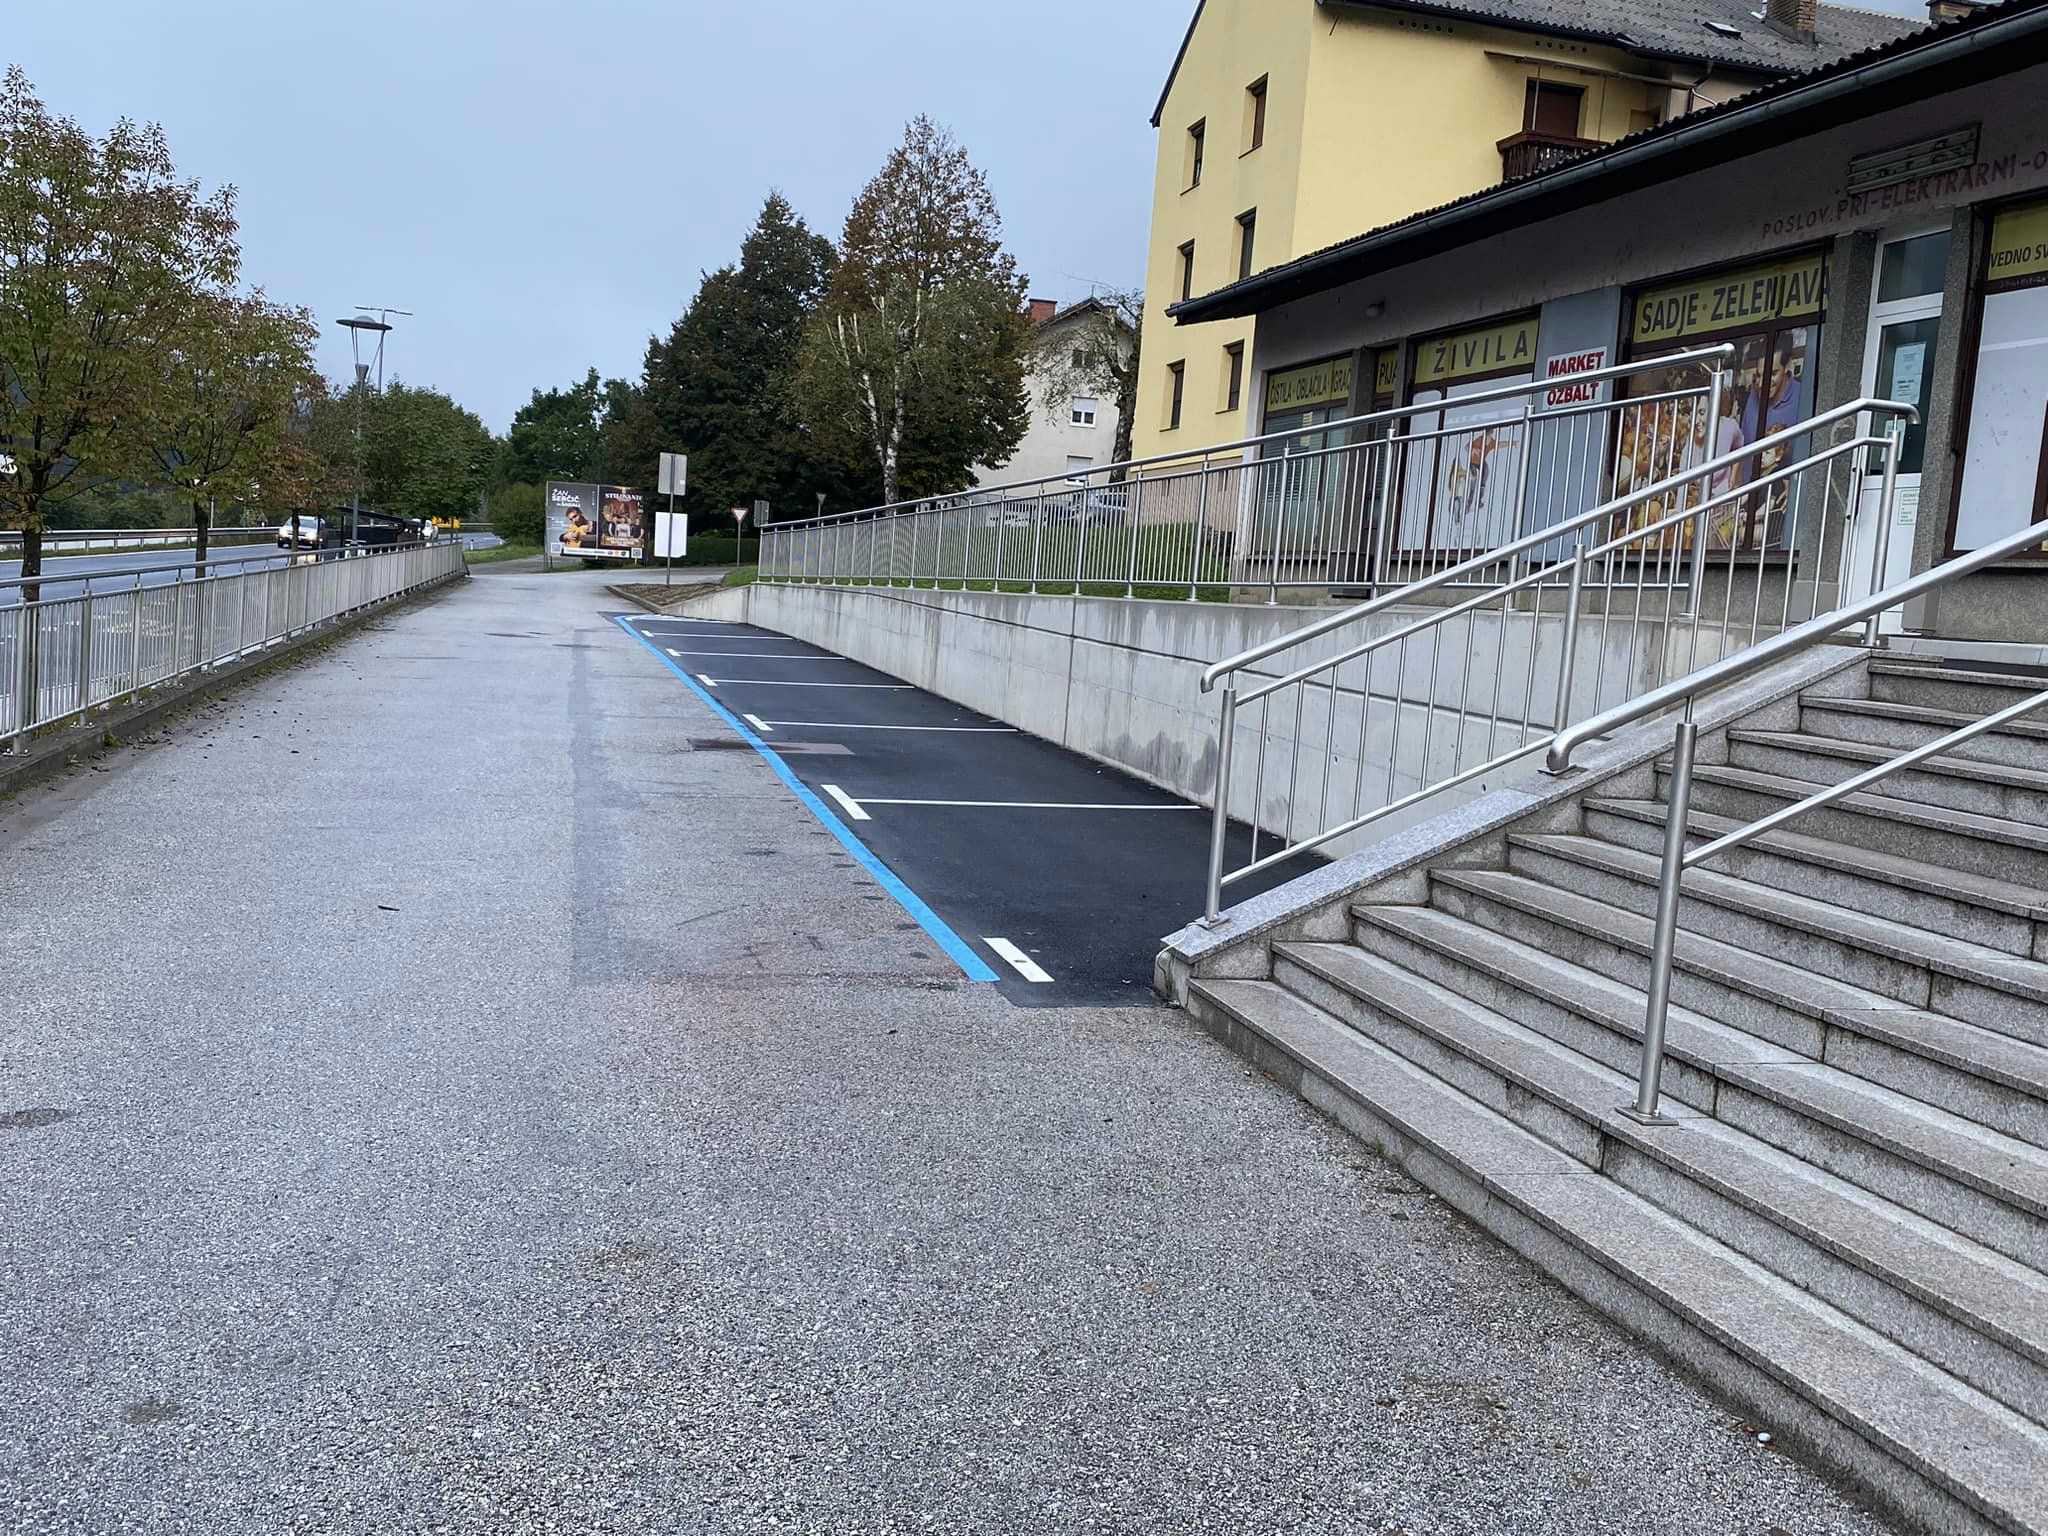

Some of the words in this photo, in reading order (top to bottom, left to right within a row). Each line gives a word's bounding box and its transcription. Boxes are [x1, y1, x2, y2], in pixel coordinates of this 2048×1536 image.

[1990, 246, 2031, 268] VEDNO
[1641, 292, 1699, 335] SADJE
[1710, 265, 1830, 322] ZELENJAVA
[1432, 330, 1528, 374] ŽIVILA
[1548, 351, 1605, 377] MARKET
